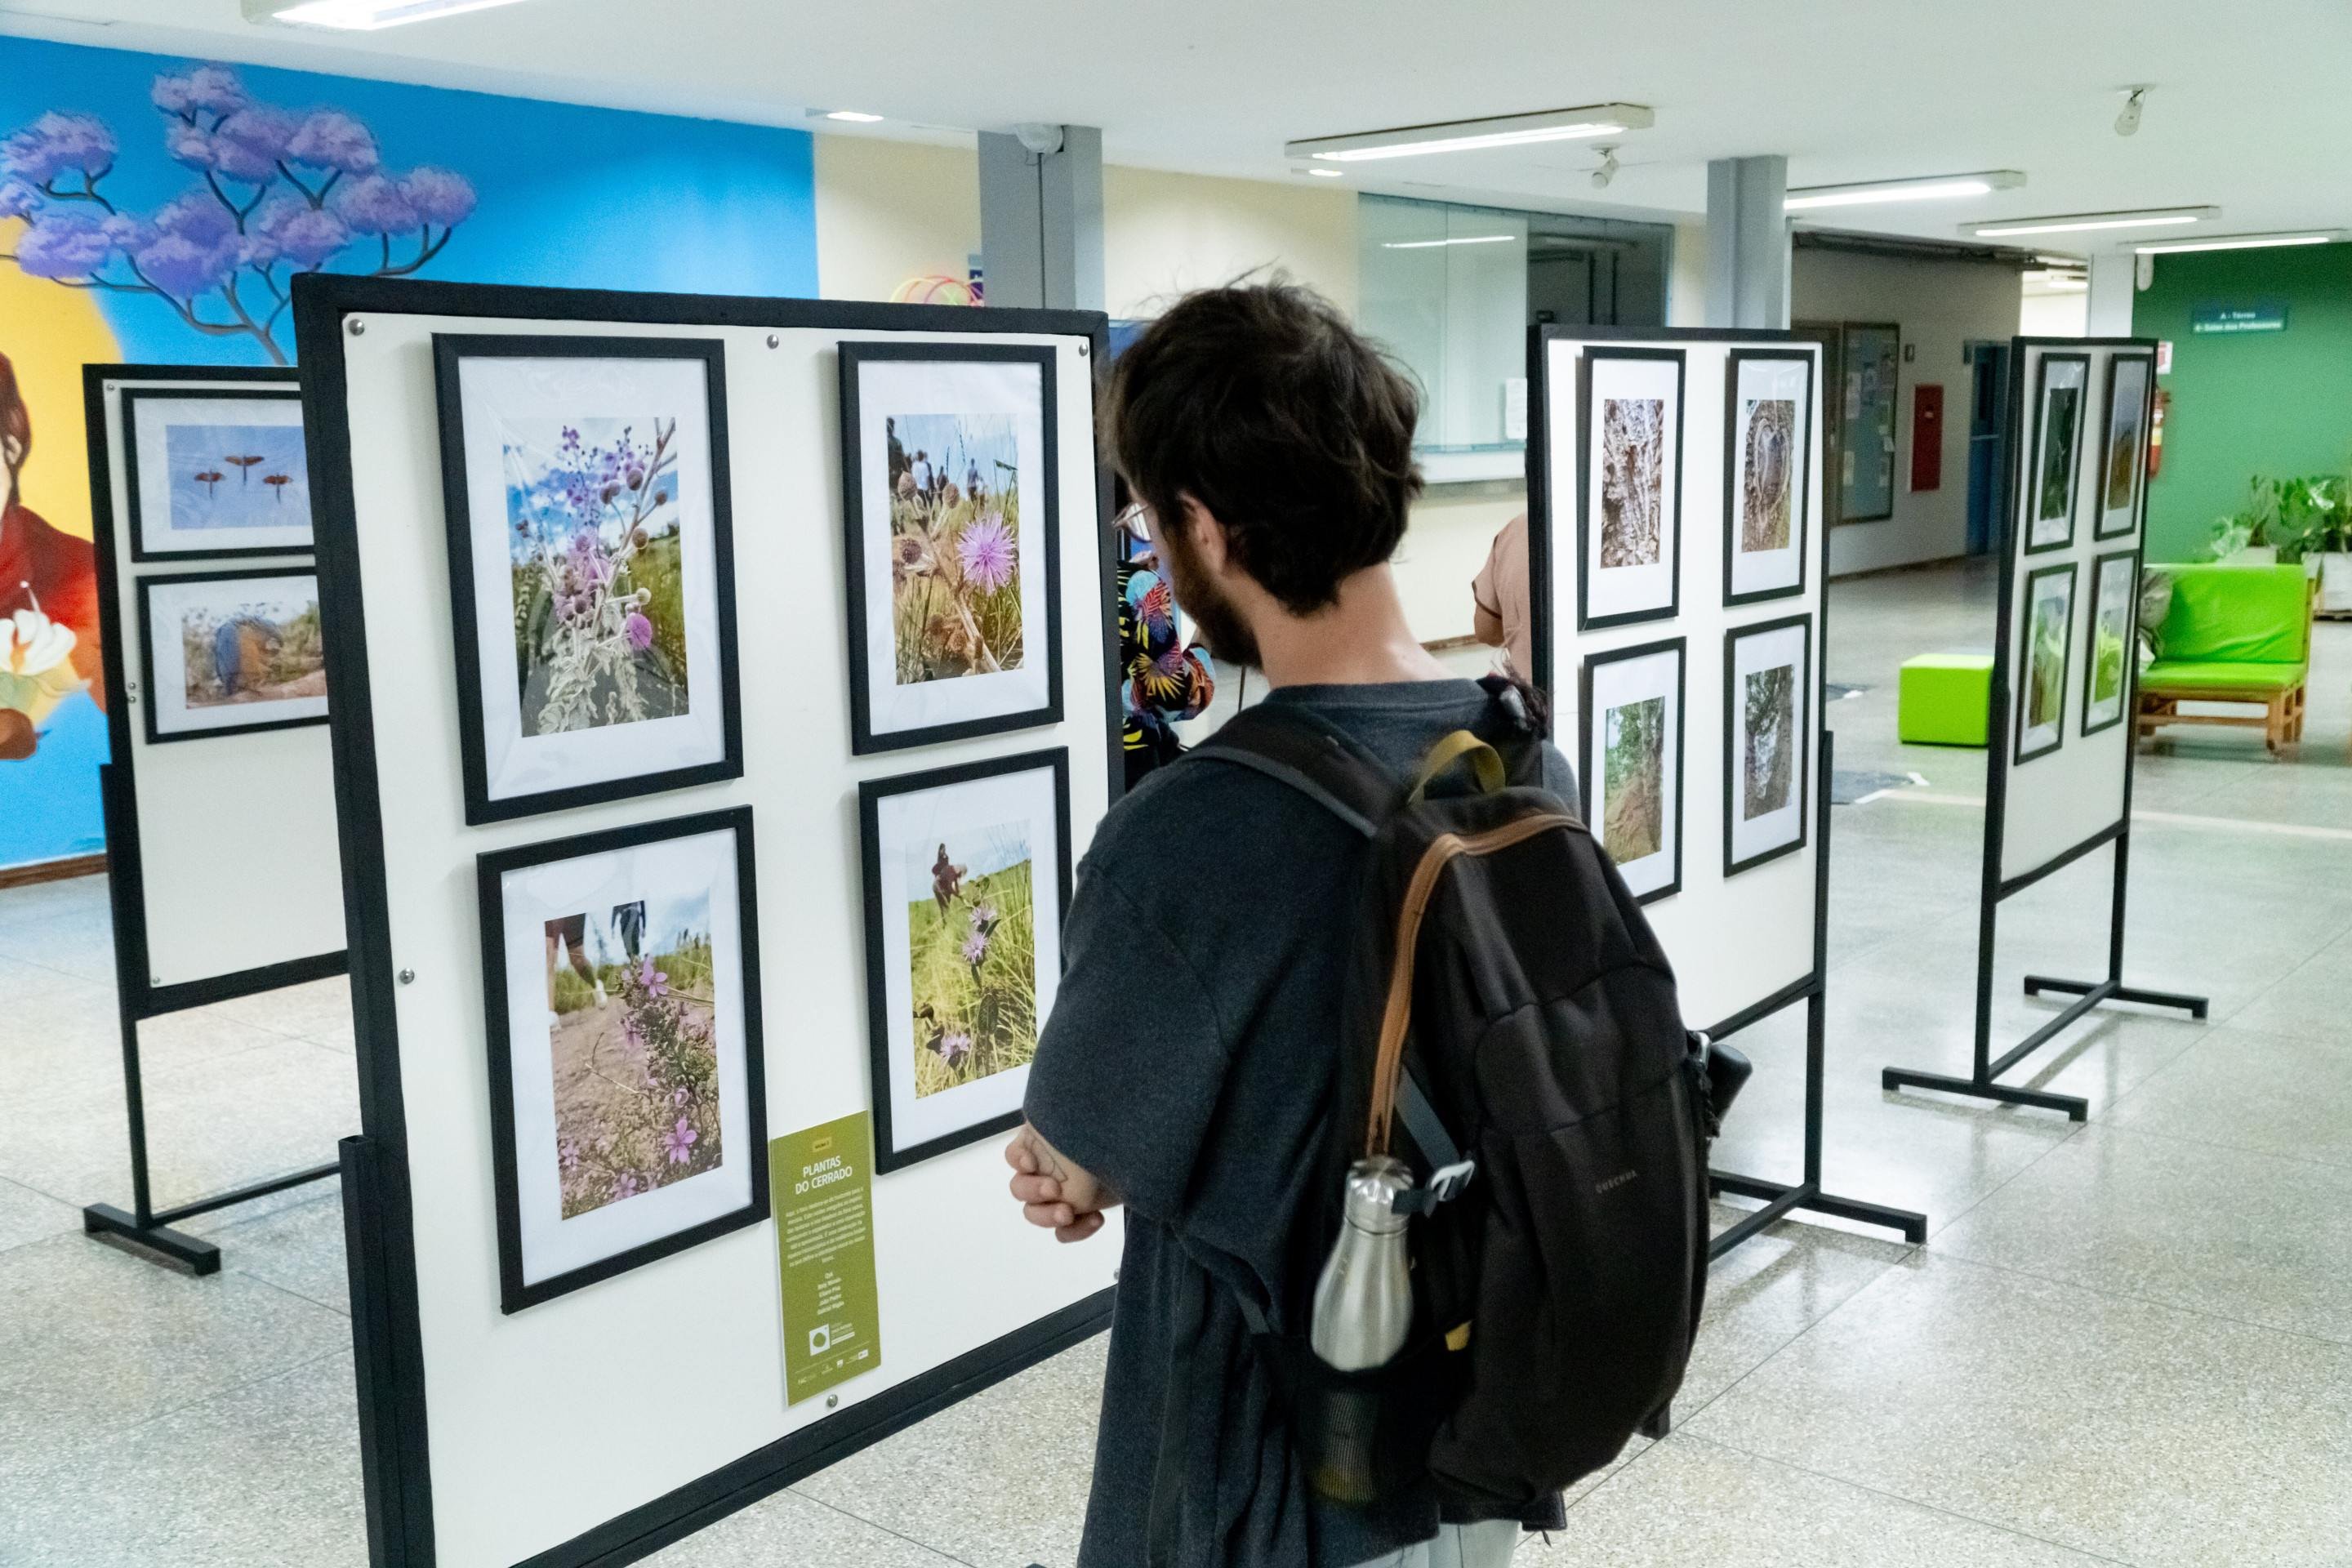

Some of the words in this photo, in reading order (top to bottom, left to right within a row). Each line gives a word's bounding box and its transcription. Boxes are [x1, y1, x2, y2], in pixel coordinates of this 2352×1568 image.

[803, 1156, 841, 1178] PLANTAS
[795, 1181, 809, 1195] DO
[811, 1166, 853, 1189] CERRADO
